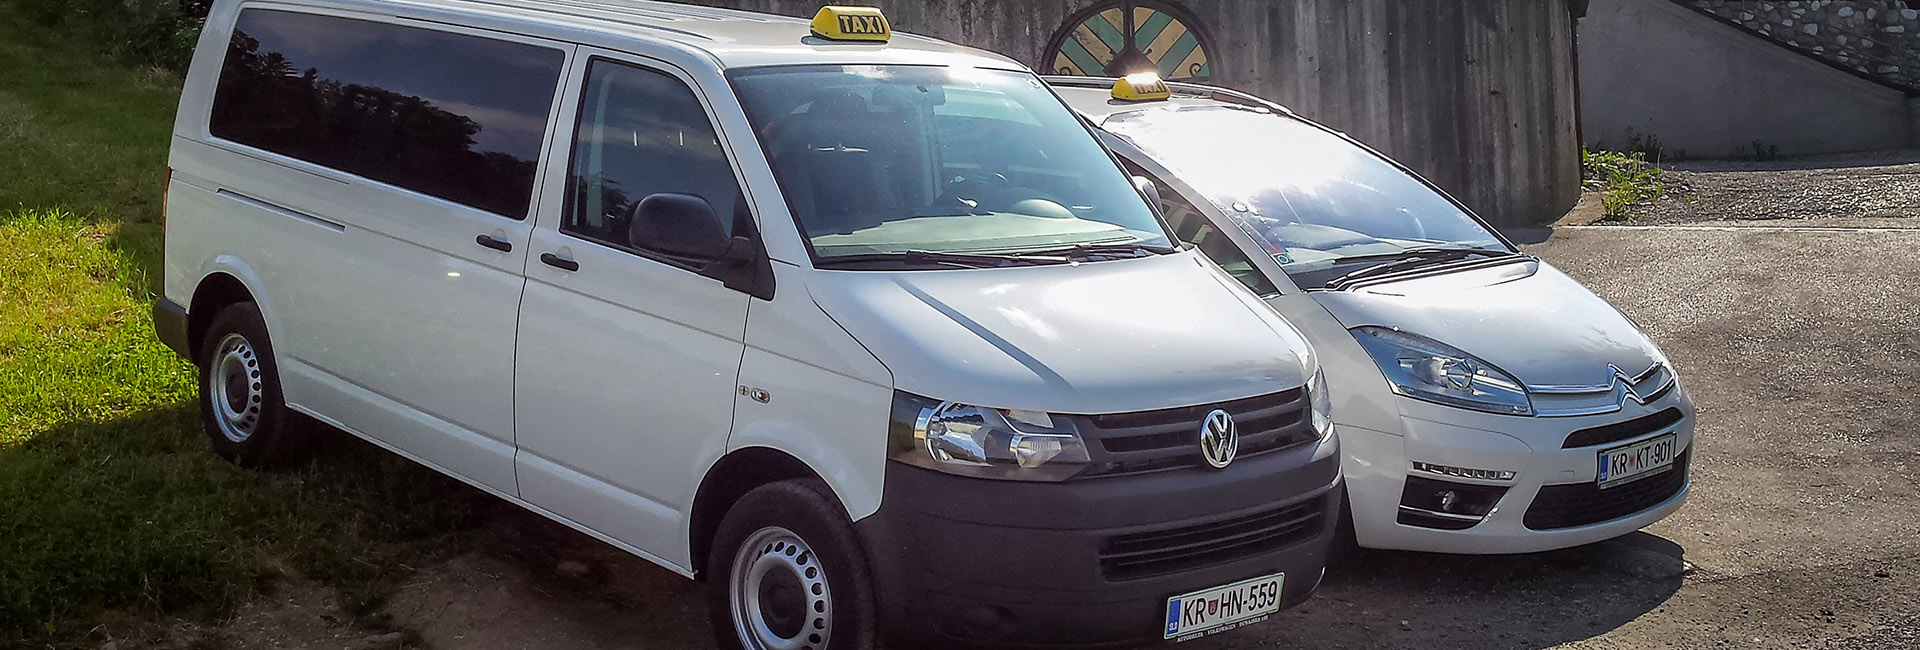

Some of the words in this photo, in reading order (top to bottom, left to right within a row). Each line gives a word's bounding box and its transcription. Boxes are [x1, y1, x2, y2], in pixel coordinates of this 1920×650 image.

[839, 15, 885, 34] TAXI
[1611, 453, 1628, 476] KR
[1636, 440, 1672, 470] KT-901
[1182, 598, 1207, 628] KR
[1220, 580, 1278, 619] HN-559
